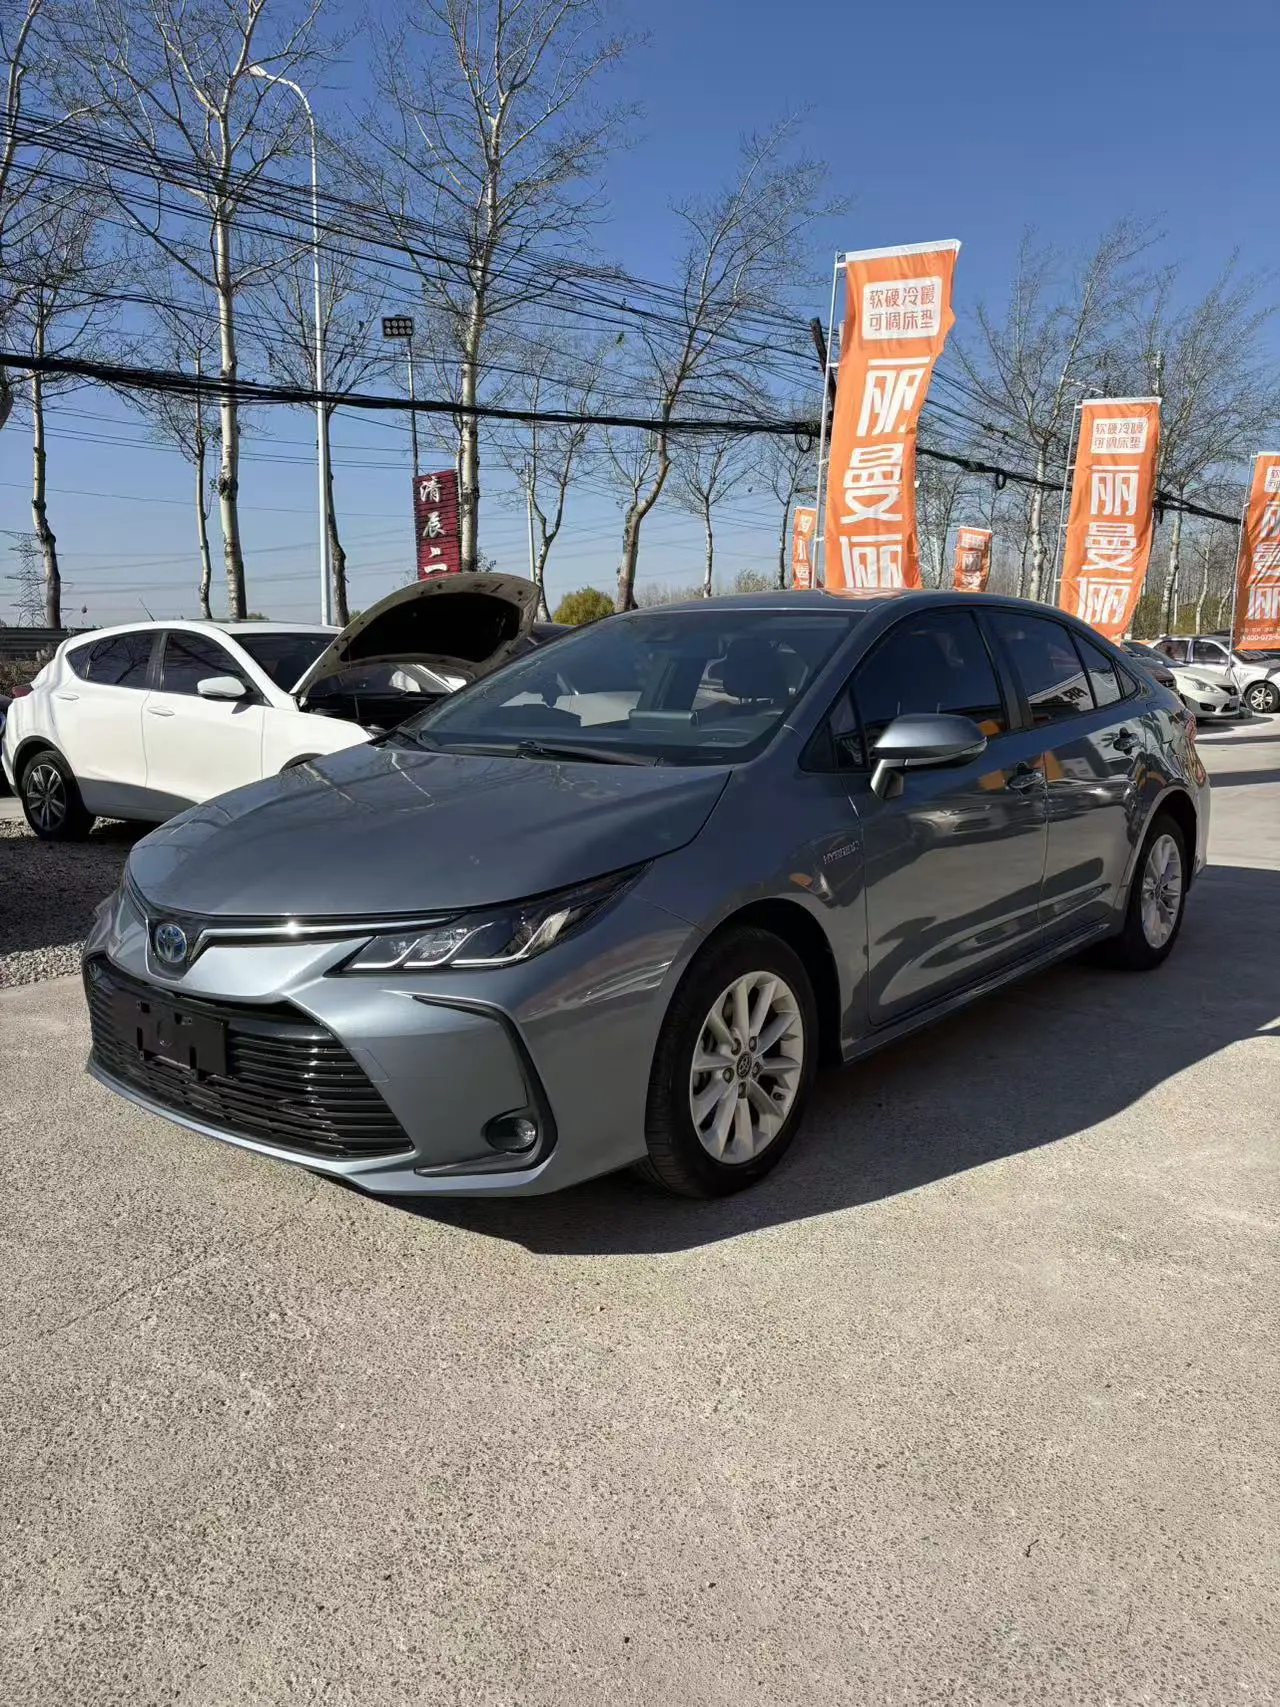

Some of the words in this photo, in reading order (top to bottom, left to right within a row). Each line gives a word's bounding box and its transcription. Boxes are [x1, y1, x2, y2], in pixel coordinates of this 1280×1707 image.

[869, 283, 935, 310] 软硬冷暖
[869, 310, 934, 331] 可调床垫
